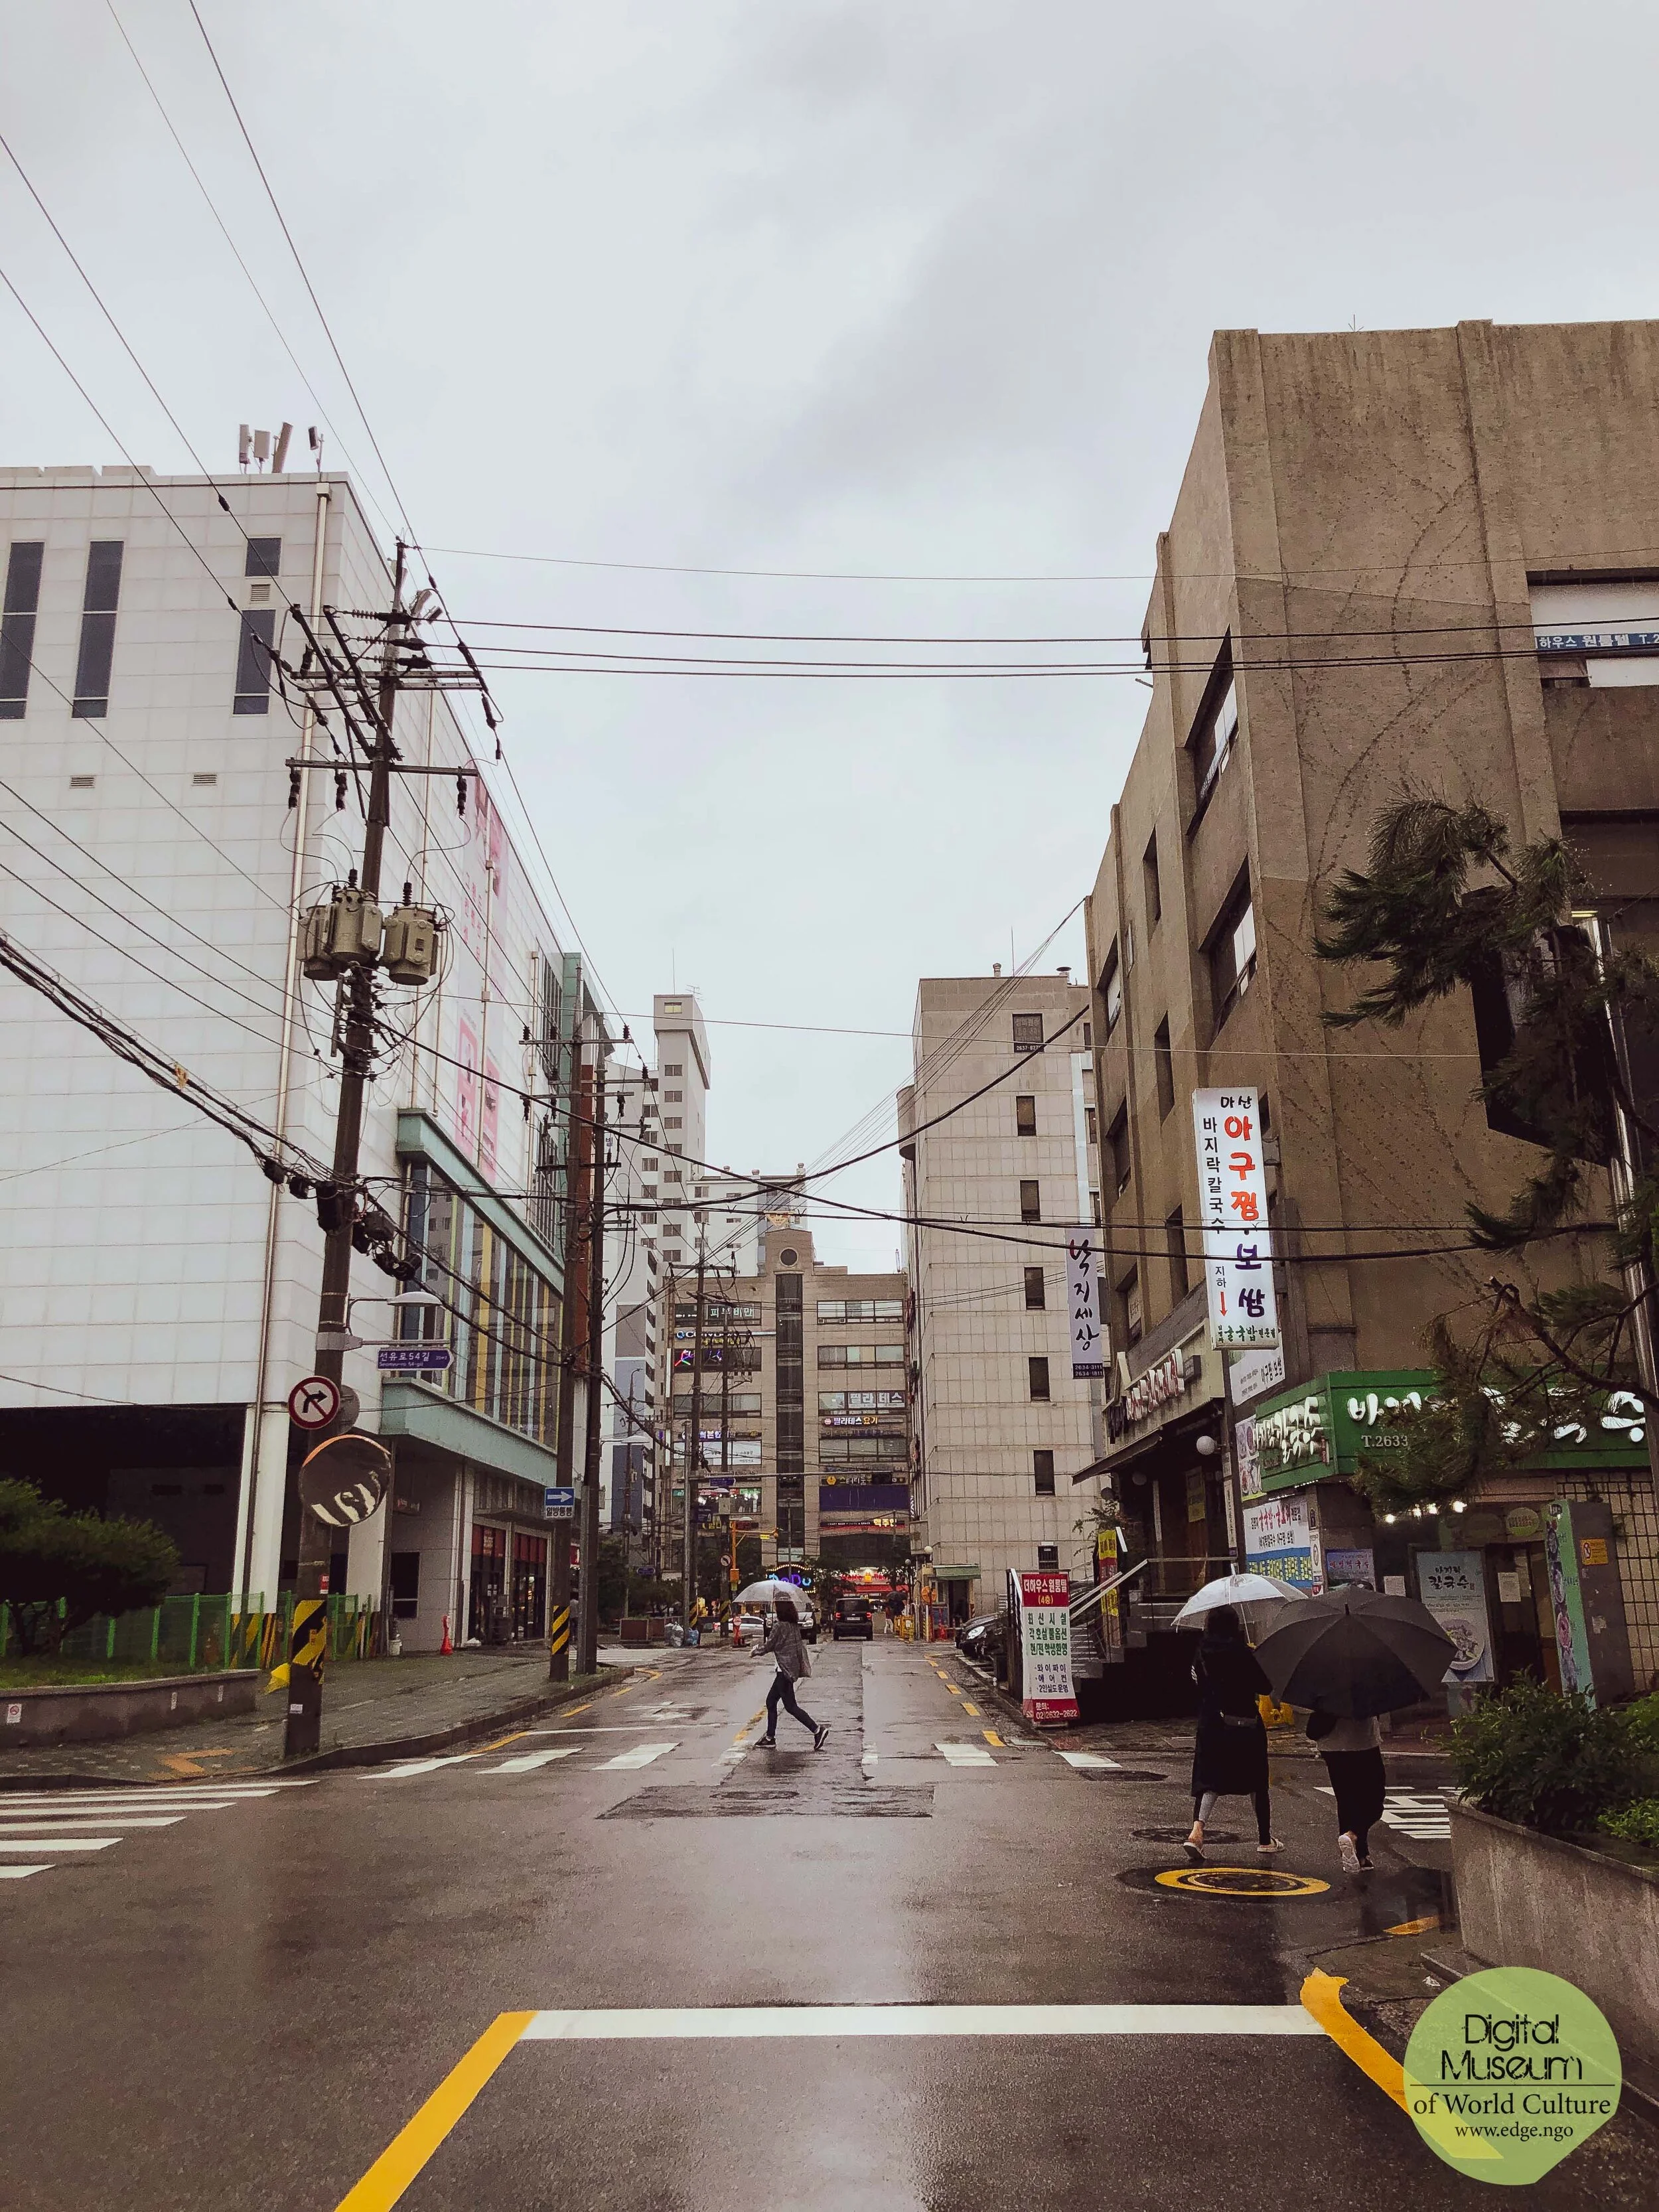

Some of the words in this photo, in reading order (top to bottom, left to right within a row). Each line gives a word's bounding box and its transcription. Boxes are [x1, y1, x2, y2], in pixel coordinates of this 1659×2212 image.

[1220, 1095, 1252, 1109] 마산
[1203, 1117, 1226, 1234] 바지락칼국수
[1215, 1266, 1227, 1288] 지하
[1070, 1239, 1100, 1351] 낙지세상
[1224, 1325, 1258, 1342] 굴국밥
[380, 1352, 430, 1362] 선유로54길
[833, 1416, 863, 1426] 필라테스
[546, 1507, 573, 1516] 일방통행
[1024, 1579, 1067, 1593] 더하우스원룸텔
[1429, 1575, 1470, 1590] 칼국수
[1038, 1595, 1054, 1604] (4층)
[1036, 1710, 1078, 1720] 02)2632-2622
